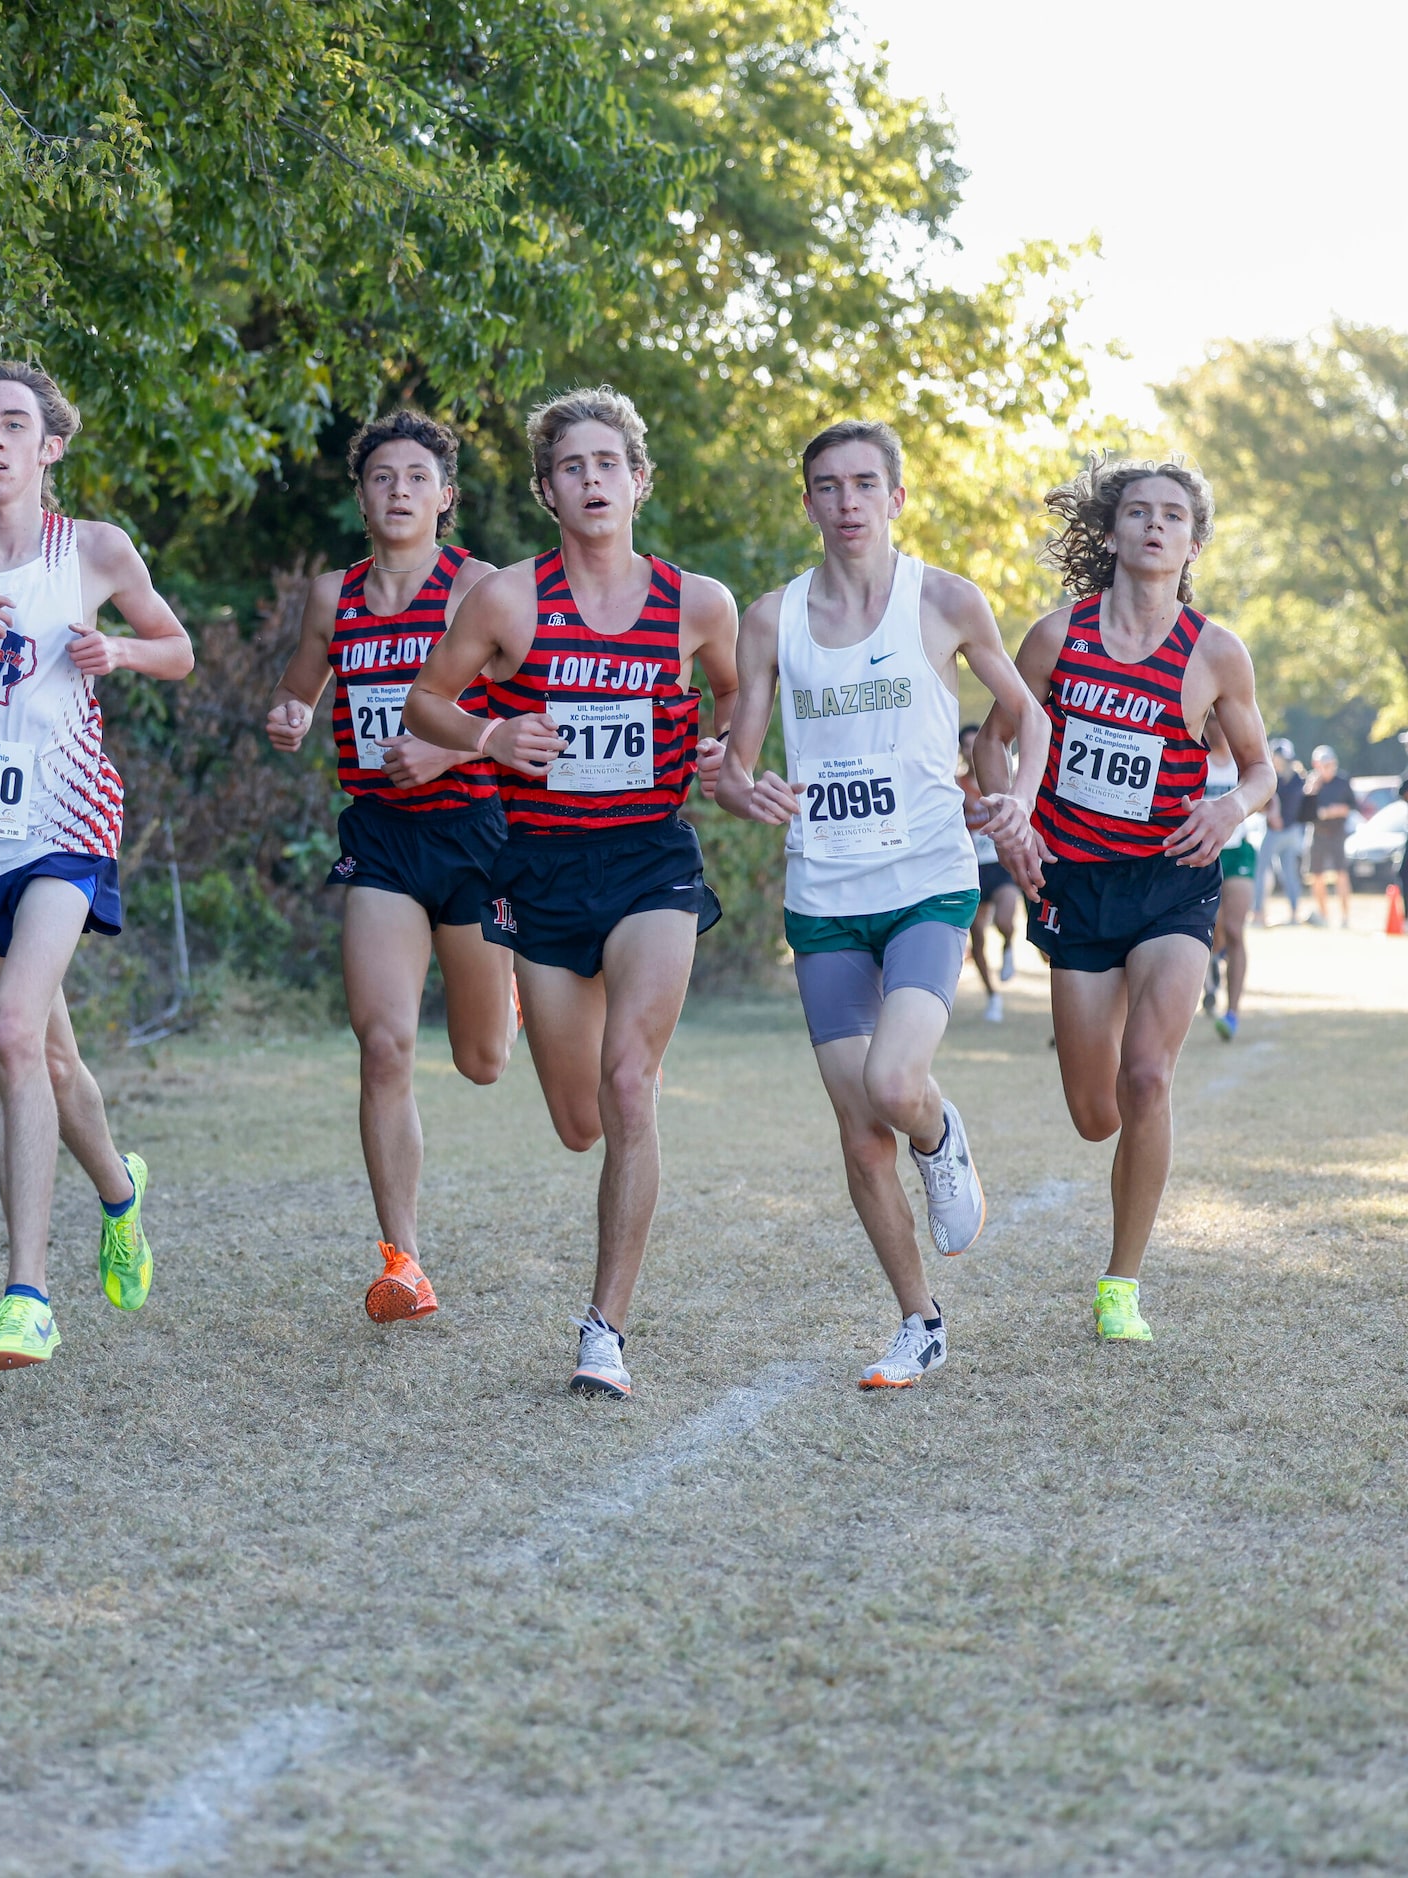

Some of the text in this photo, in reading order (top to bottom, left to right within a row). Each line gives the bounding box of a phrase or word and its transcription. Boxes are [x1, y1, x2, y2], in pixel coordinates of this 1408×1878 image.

[342, 636, 433, 673] LOVEJOY
[547, 655, 662, 692] LOVEJOY
[380, 687, 401, 696] Region
[792, 677, 912, 720] BLAZERS
[590, 704, 614, 713] Region
[1060, 678, 1166, 728] LOVEJOY
[358, 706, 407, 739] 217
[581, 713, 630, 722] Championship
[557, 722, 645, 760] 2176
[1085, 733, 1140, 752] XC Championship
[1093, 727, 1103, 735] UIL
[1104, 729, 1127, 740] Region
[823, 758, 863, 769] UIL Region II
[827, 767, 874, 779] Championship
[1066, 740, 1152, 790] 2169
[807, 777, 896, 822] 2095
[1084, 786, 1120, 800] ARLINGTON
[833, 827, 872, 837] ARLINGTON
